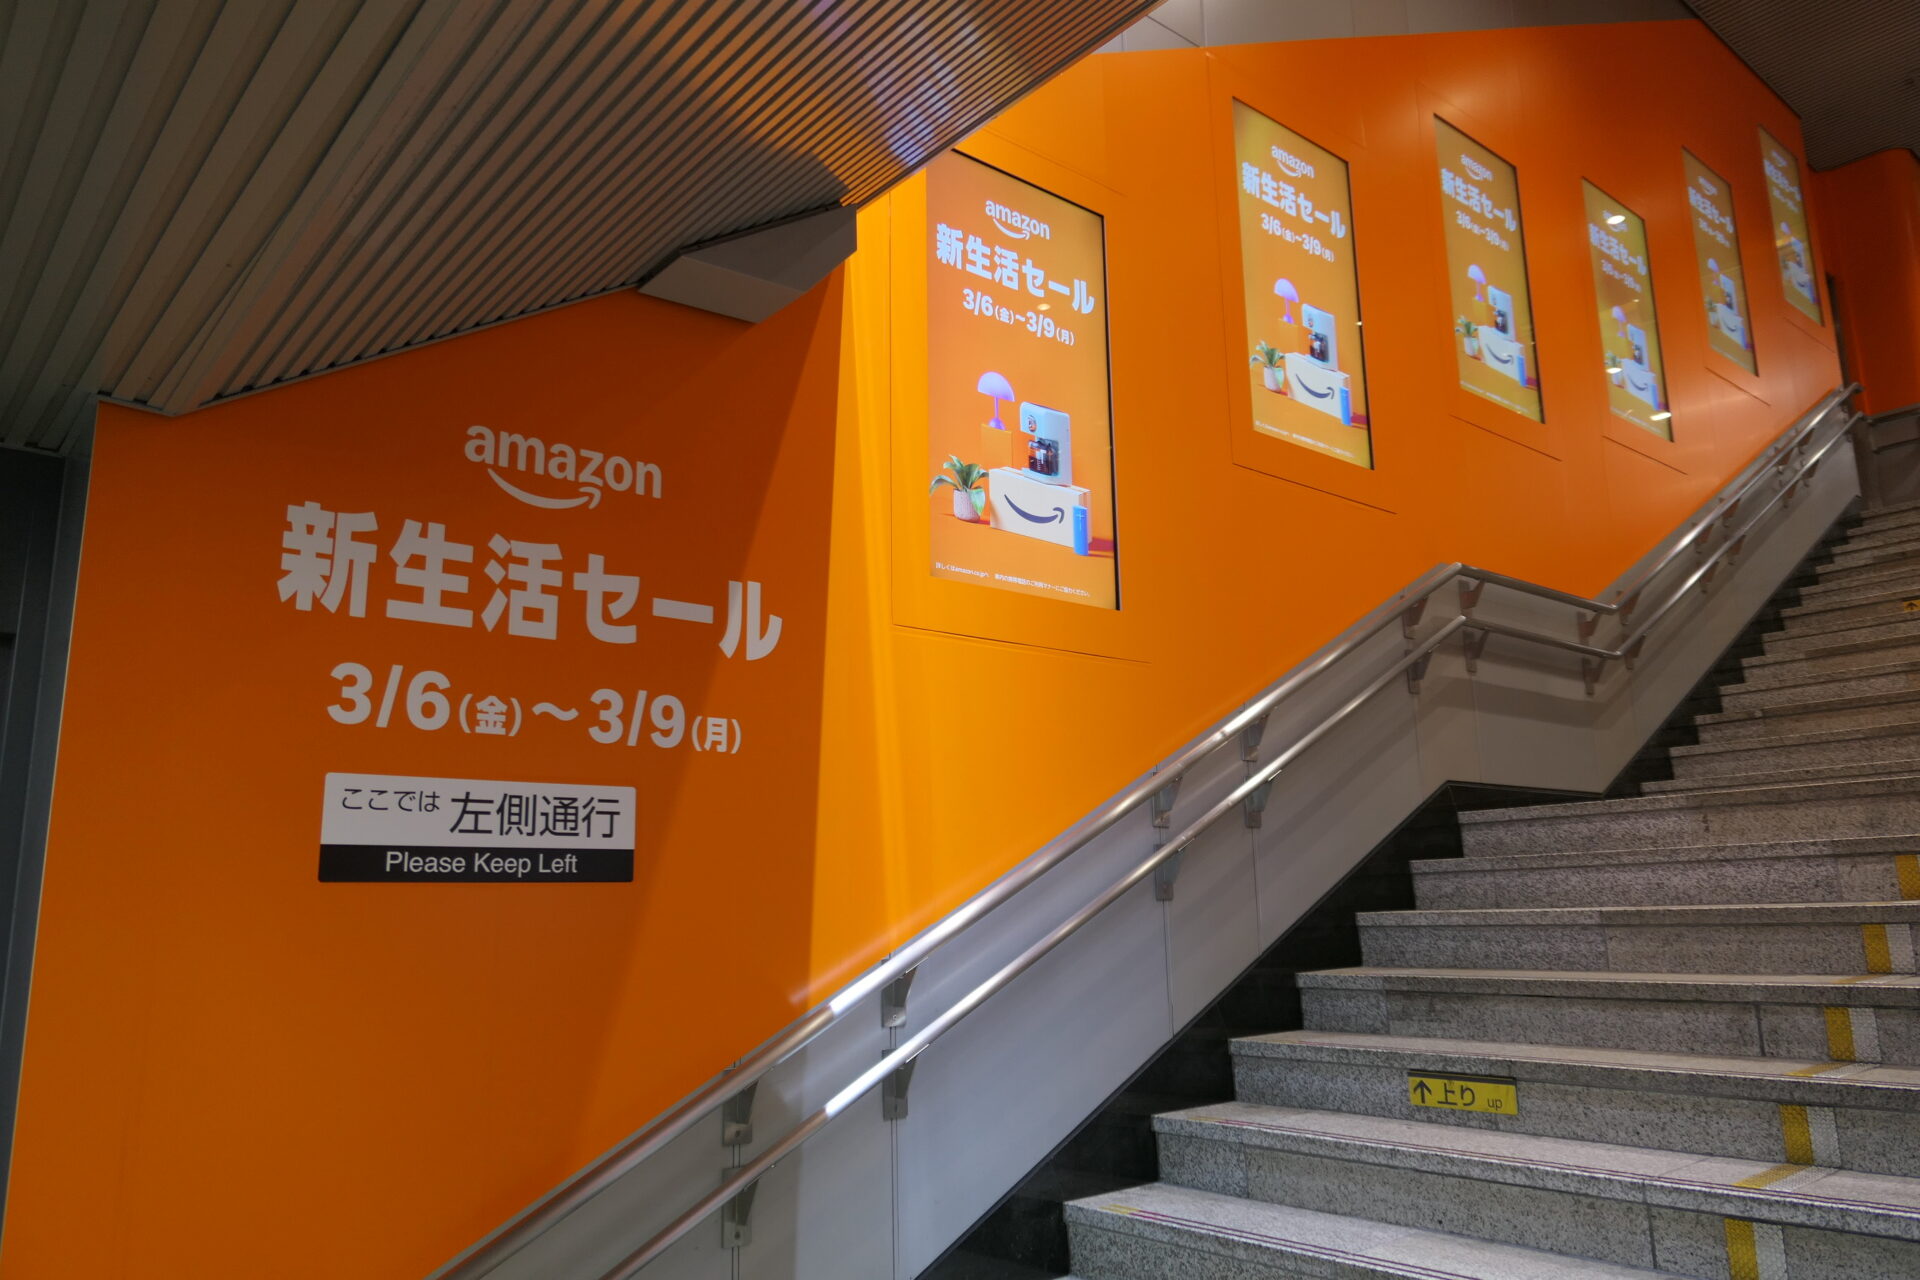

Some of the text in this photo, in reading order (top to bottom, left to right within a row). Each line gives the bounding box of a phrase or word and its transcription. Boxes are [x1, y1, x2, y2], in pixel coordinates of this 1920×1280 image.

[1271, 145, 1315, 179] amazon
[985, 200, 1051, 240] amazon
[1242, 162, 1346, 238] 新生活セール
[936, 223, 1095, 314] 新生活セール
[465, 424, 662, 499] amazon
[276, 501, 783, 661] 新生活セール
[341, 787, 621, 838] ここでは 左側通行
[385, 851, 578, 877] Please Keep Left
[1437, 1082, 1503, 1111] 上り up
